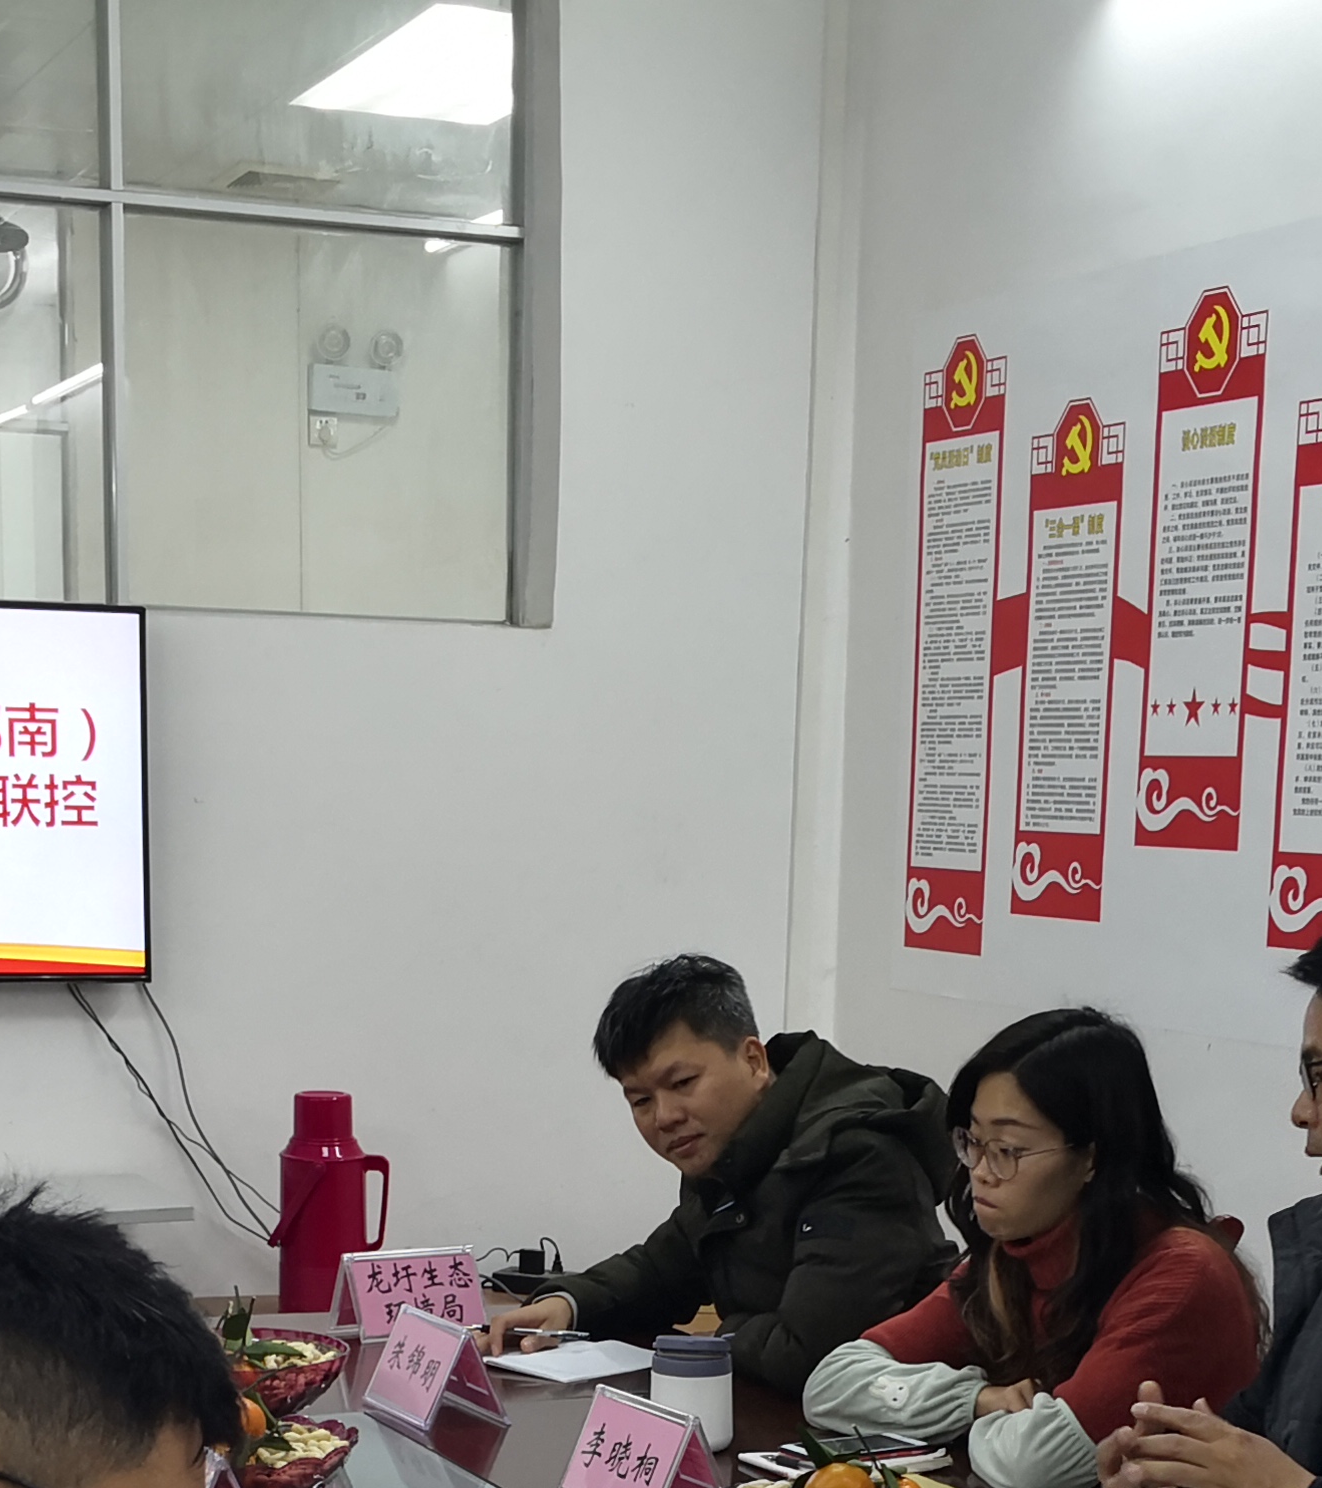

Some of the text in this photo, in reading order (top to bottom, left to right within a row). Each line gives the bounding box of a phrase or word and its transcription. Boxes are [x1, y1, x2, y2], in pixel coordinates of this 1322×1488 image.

[366, 1256, 474, 1294] 龙圩生态
[581, 1423, 659, 1487] 李晓桐
